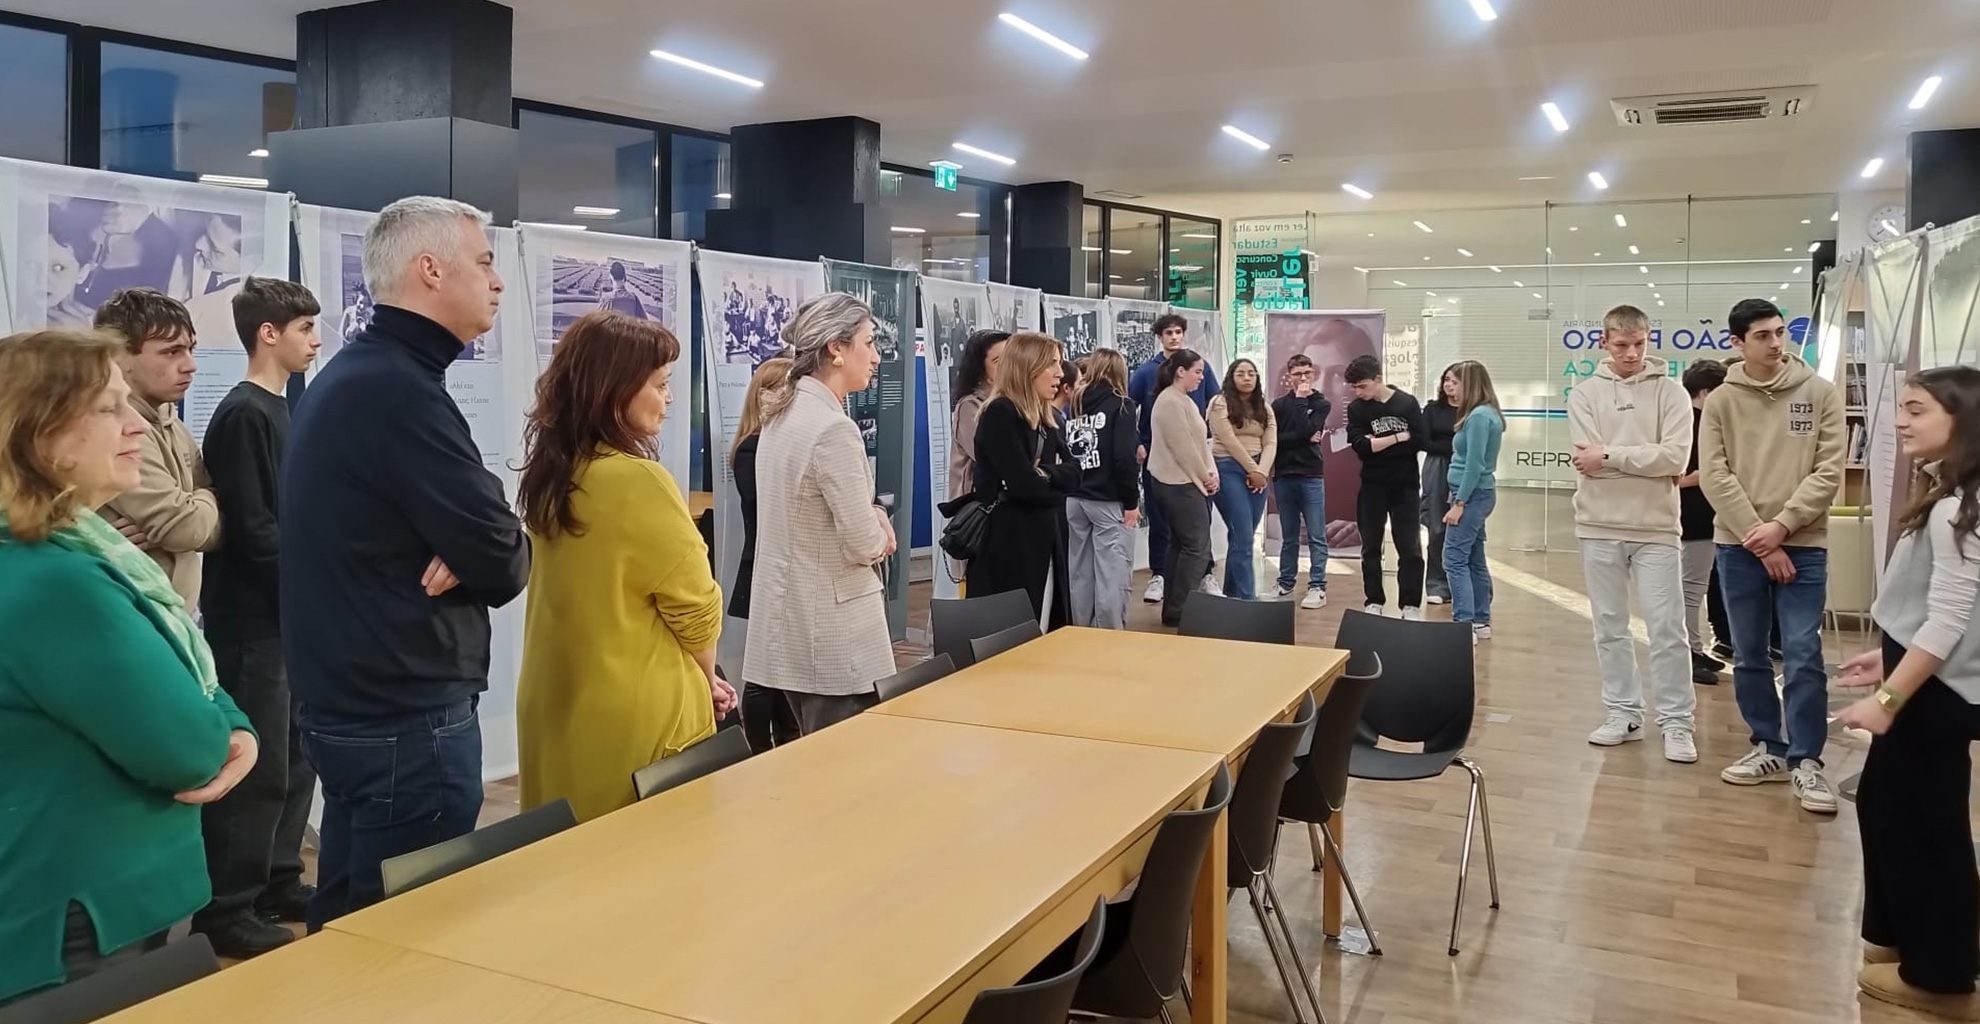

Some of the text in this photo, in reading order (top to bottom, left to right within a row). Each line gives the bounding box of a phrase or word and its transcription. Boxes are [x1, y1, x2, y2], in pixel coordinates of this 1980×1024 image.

[1790, 403, 1814, 414] 1973
[1790, 420, 1813, 431] 1973
[1516, 451, 1572, 467] REPR
